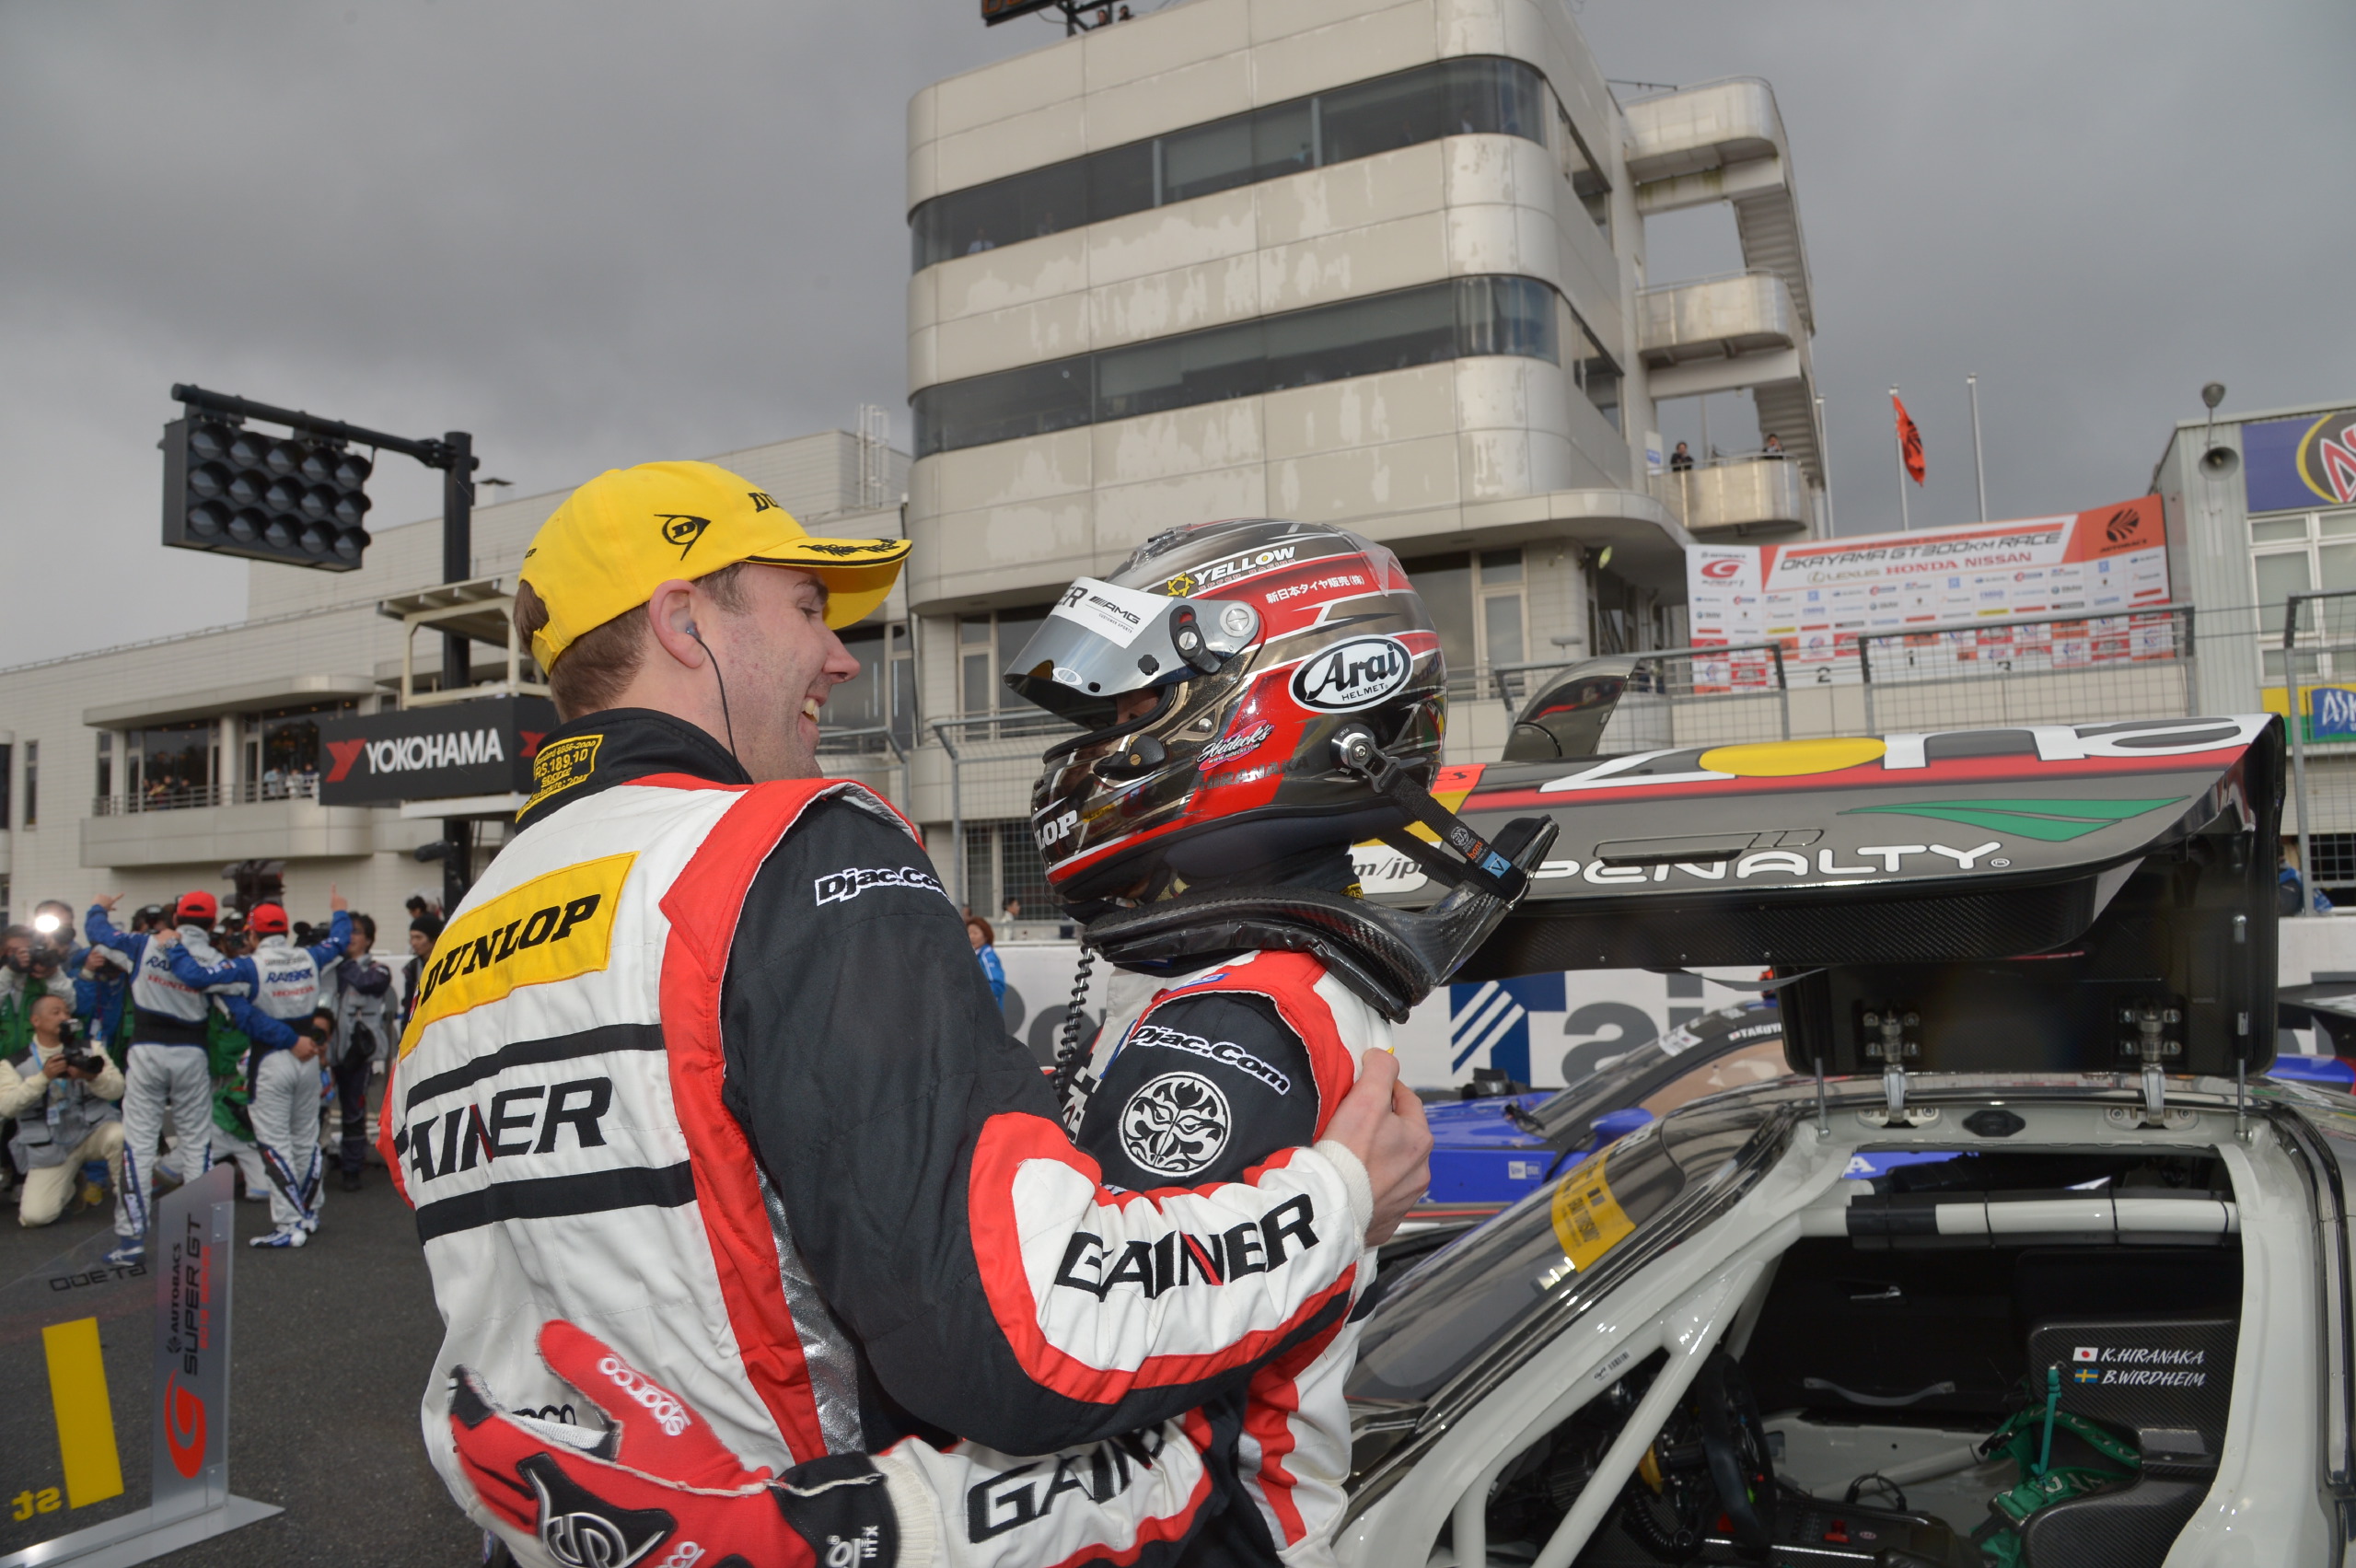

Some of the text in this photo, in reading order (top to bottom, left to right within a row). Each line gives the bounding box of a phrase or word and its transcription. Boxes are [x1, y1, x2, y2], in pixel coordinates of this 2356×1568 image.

[1194, 546, 1295, 587] YELLOW
[1781, 549, 1886, 571] OKAYAMA
[1998, 531, 2061, 552] RACE
[1827, 552, 2032, 582] LEXUS HONDA NISSAN
[1305, 642, 1400, 702] Arai
[365, 727, 505, 774] YOKOHAMA
[1534, 841, 2002, 886] PENALTY
[421, 893, 601, 1007] DUNLOP
[1130, 1026, 1291, 1096] Djac.Com
[396, 1076, 613, 1183] AINER
[1055, 1193, 1320, 1302] GAINER
[170, 1241, 181, 1333] AUTOBACS
[183, 1212, 202, 1376] SUPER GT
[2100, 1347, 2205, 1365] K.HIRANAKA
[2102, 1369, 2206, 1387] B.WIRDHEIM
[597, 1354, 691, 1436] sparco
